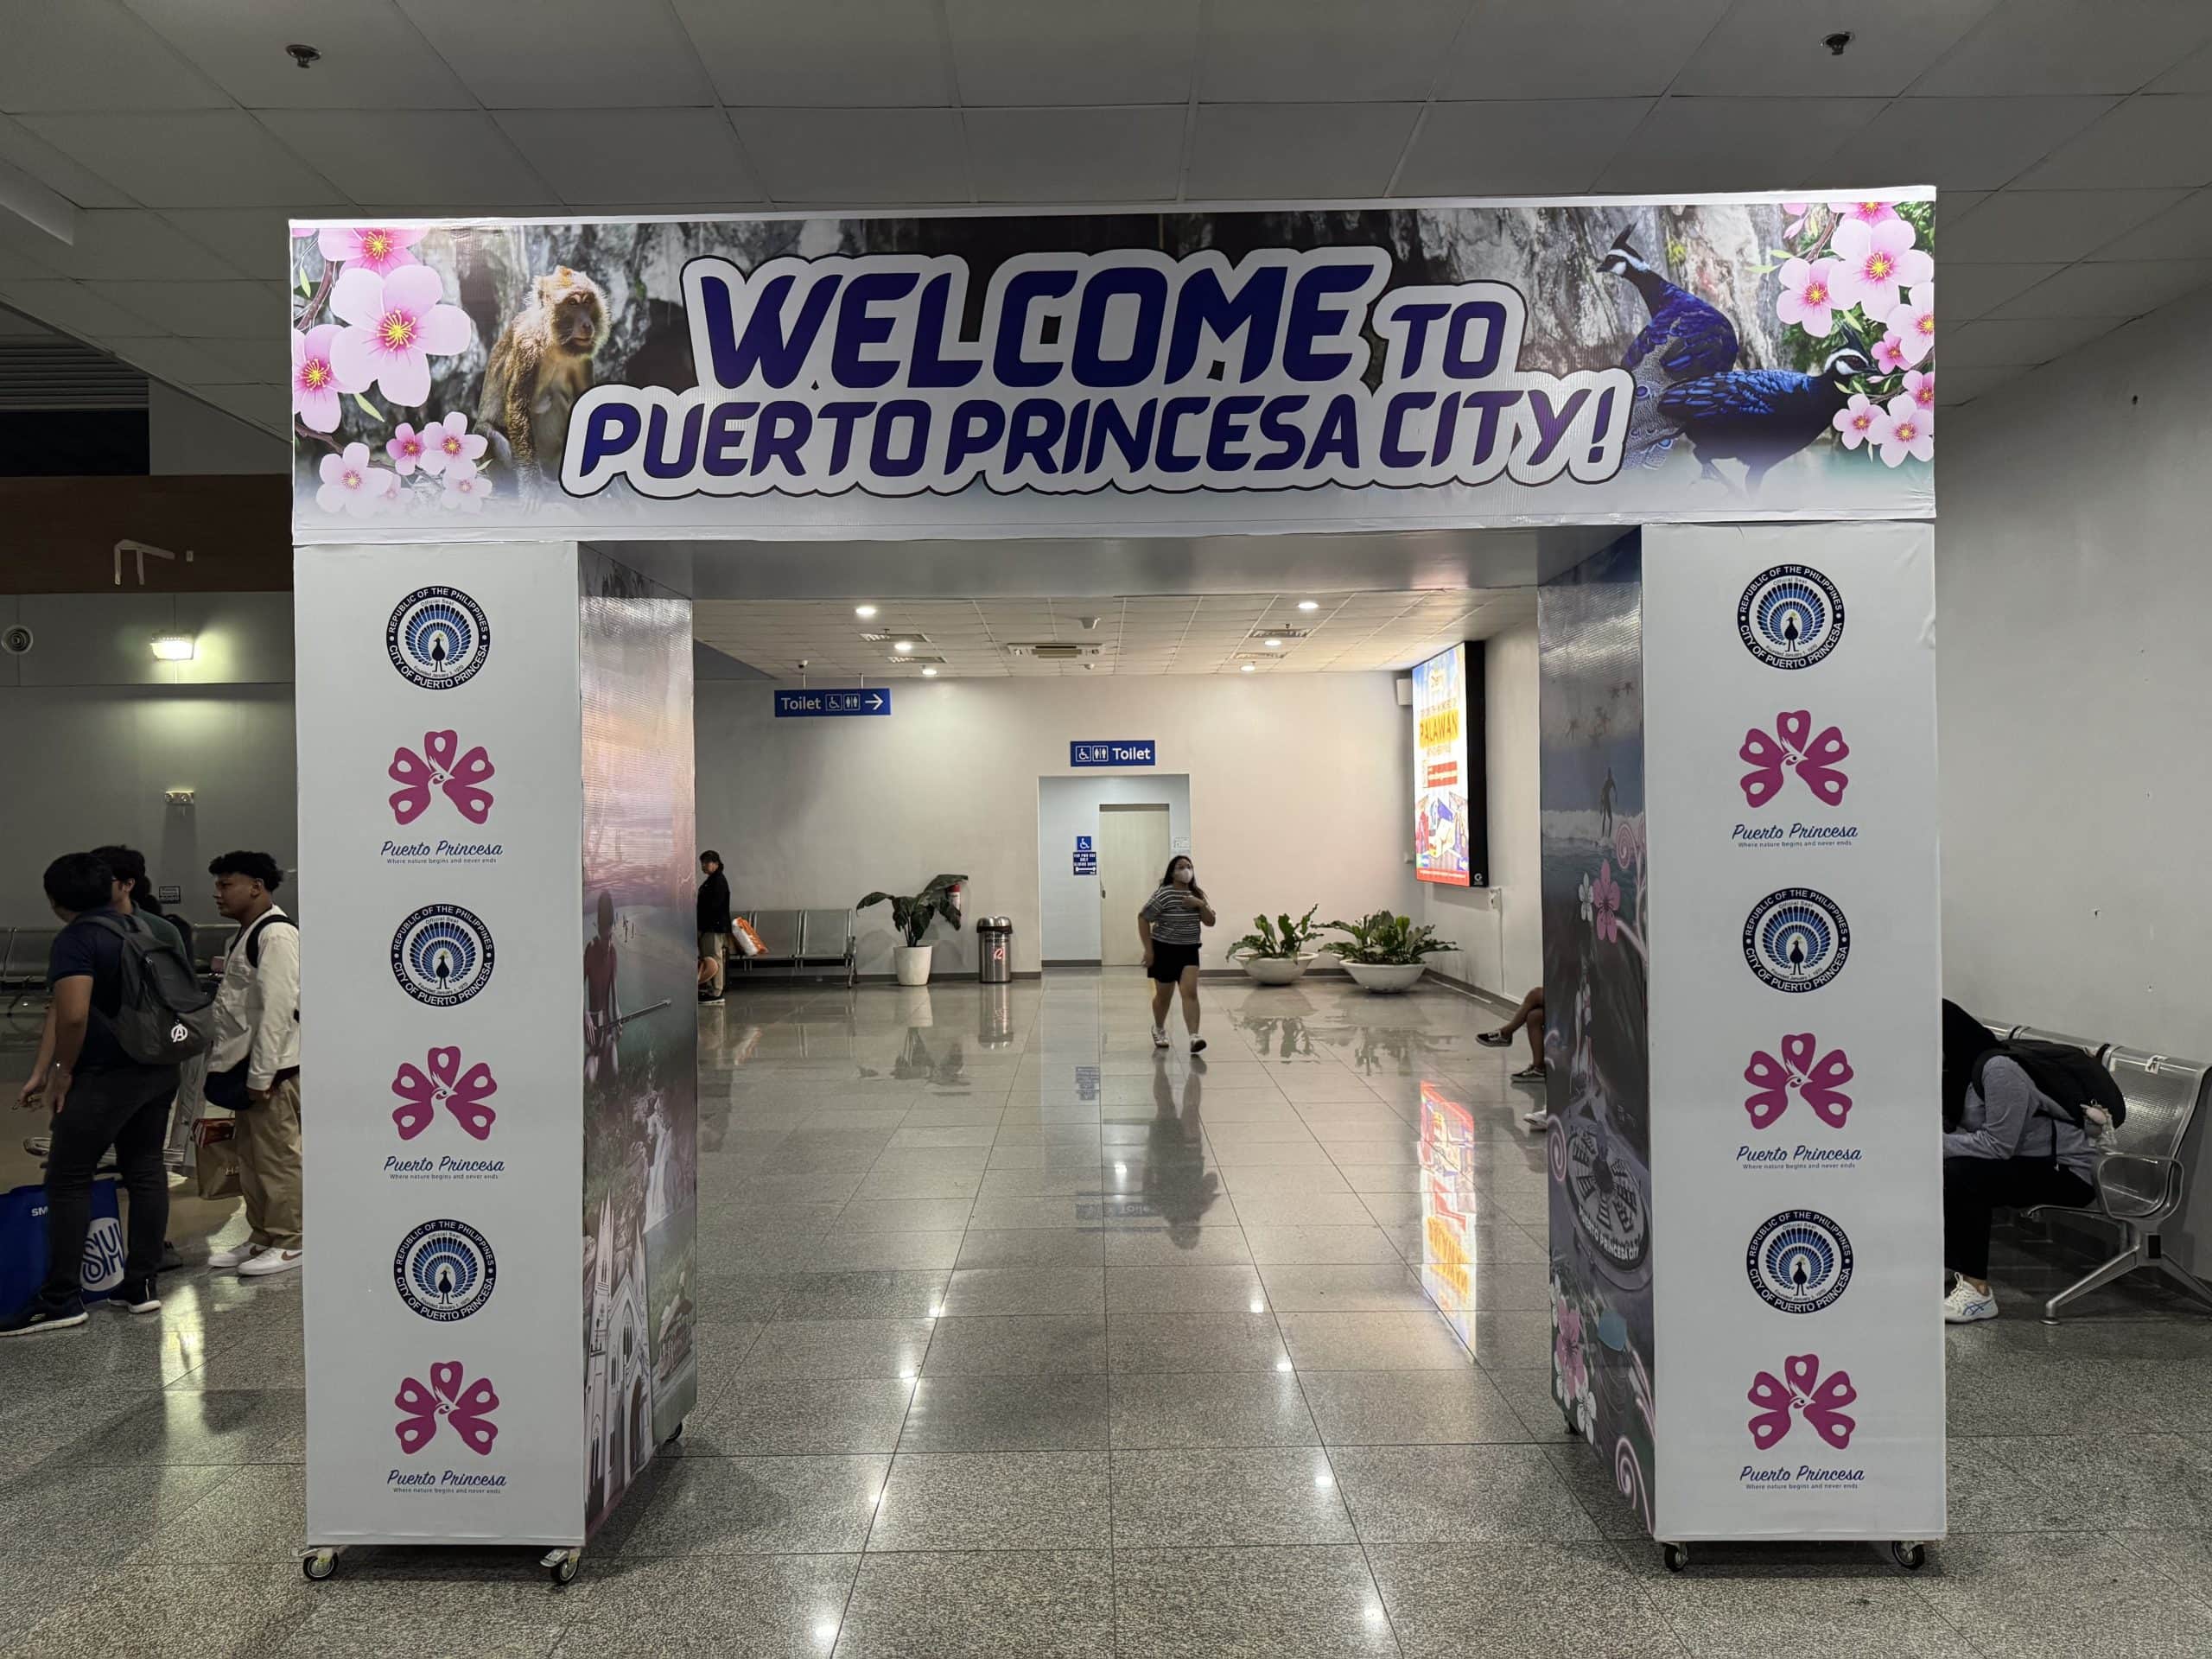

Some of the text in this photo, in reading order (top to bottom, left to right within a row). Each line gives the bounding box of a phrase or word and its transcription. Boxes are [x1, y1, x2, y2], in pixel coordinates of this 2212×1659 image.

[700, 264, 1507, 389] WELCOME TO
[580, 386, 1615, 479] PUERTO PRINCESA CITY!
[389, 594, 416, 632] REPUBLIC
[416, 589, 429, 598] OF
[450, 590, 487, 632] PHILIPPINES
[1740, 574, 1768, 612] REPUBLIC
[1768, 568, 1781, 577] OF
[1802, 568, 1841, 610] PHILIPPINES
[389, 644, 487, 688] CITY OF PUERTO PRINCESA
[1740, 622, 1842, 668] CITY OF PUERTO PRINCESA
[780, 696, 821, 710] Toilet
[1112, 747, 1151, 760] Toilet
[381, 840, 503, 855] Puerto Princesa
[1732, 823, 1858, 840] Puerto Princesa
[393, 912, 421, 950] REPUBLIC
[421, 907, 434, 916] OF
[454, 908, 492, 950] PHILIPPINES
[1745, 897, 1774, 935] REPUBLIC
[1774, 891, 1787, 900] OF
[1808, 892, 1847, 934] PHILIPPINES
[393, 961, 493, 1005] CITY OF PUERTO PRINCESA
[1745, 946, 1847, 991] CITY OF PUERTO PRINCESA
[384, 1156, 505, 1171] Puerto Princesa
[1737, 1145, 1862, 1161] Puerto Princesa
[397, 1228, 423, 1265] REPUBLIC
[423, 1223, 436, 1231] OF
[457, 1224, 493, 1265] PHILIPPINES
[1750, 1218, 1777, 1256] REPUBLIC
[1777, 1213, 1790, 1222] OF
[1812, 1214, 1850, 1255] PHILIPPINES
[396, 1275, 493, 1319] CITY OF PUERTO PRINCESA
[1749, 1268, 1764, 1290] CITY
[1760, 1287, 1775, 1302] OF
[1773, 1297, 1815, 1312] PUERTO
[1815, 1268, 1851, 1308] PRINCESA
[387, 1470, 506, 1485] Puerto Princesa
[1740, 1465, 1865, 1481] Puerto Princesa
